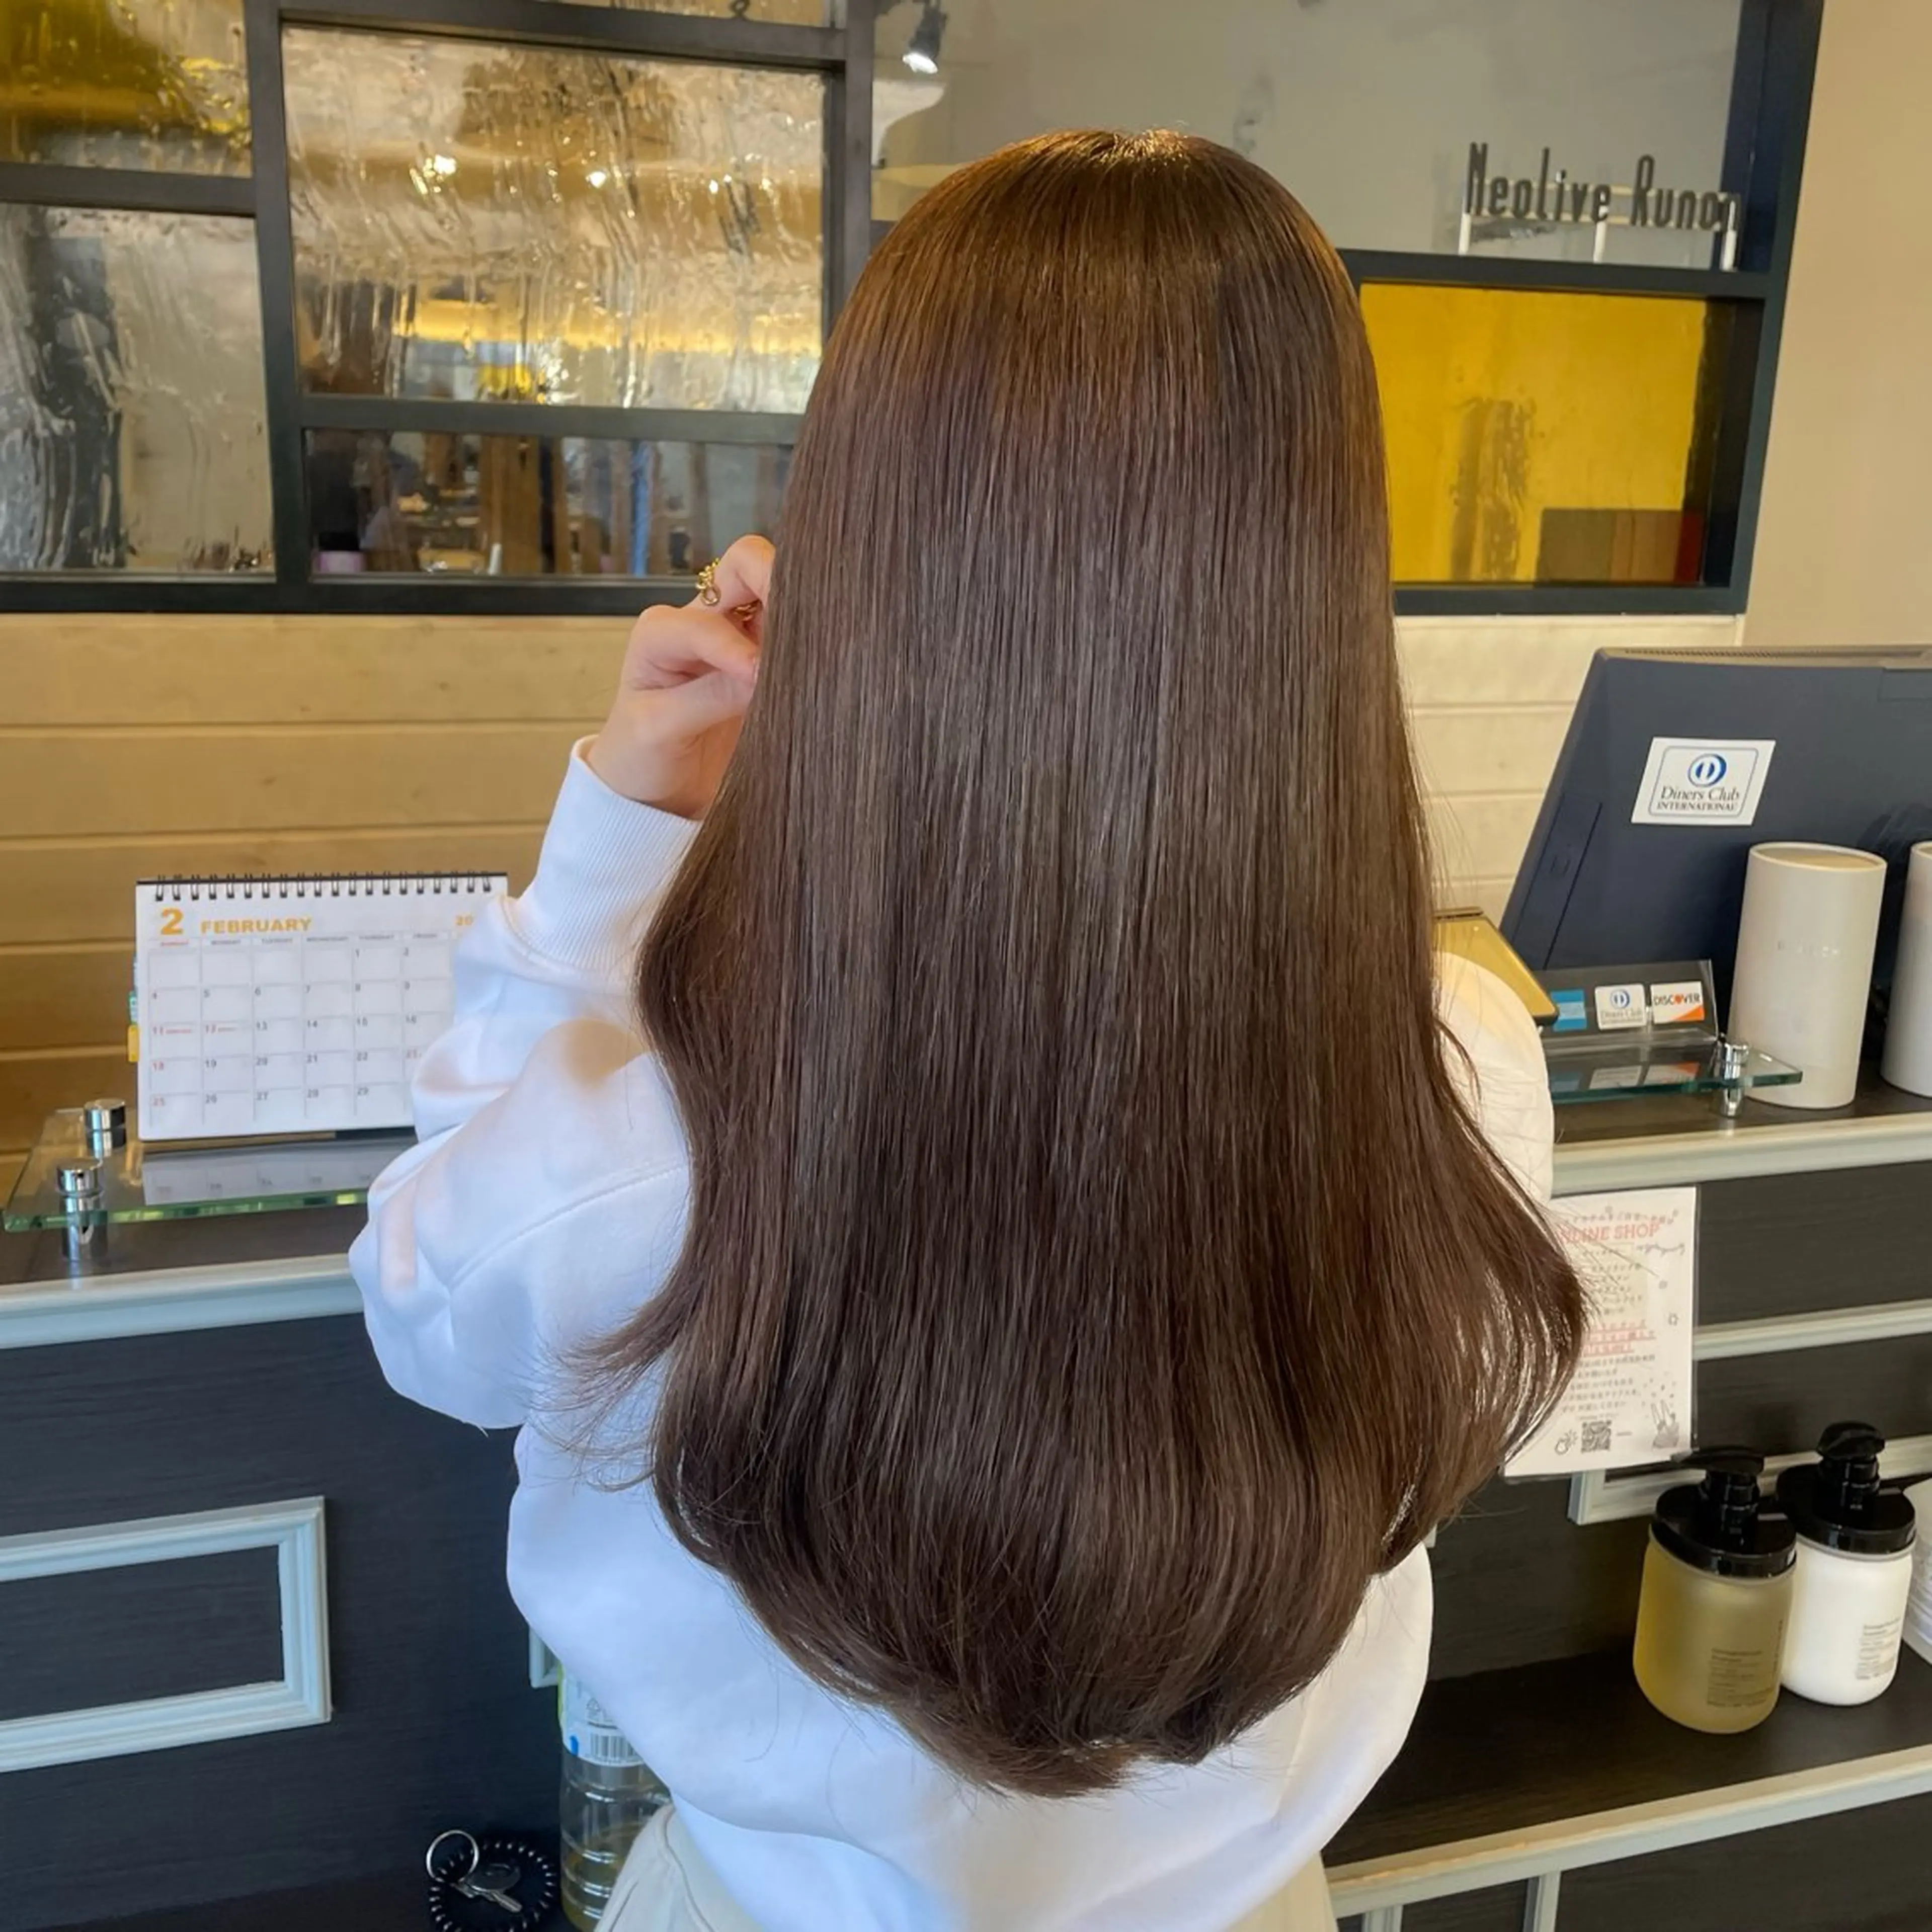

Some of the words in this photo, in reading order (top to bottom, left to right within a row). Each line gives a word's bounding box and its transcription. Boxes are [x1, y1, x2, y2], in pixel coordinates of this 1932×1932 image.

[1661, 785, 1705, 800] Diners
[1708, 786, 1739, 801] Club
[1656, 801, 1738, 811] INTERNATIONAL
[161, 908, 183, 935] 2
[201, 917, 312, 935] FEBRUARY
[455, 914, 474, 926] 20
[1654, 993, 1700, 1006] DISCOVER
[256, 1021, 268, 1030] 13
[307, 1019, 318, 1028] 14
[205, 1059, 217, 1068] 19
[307, 1054, 318, 1064] 21
[1614, 1221, 1660, 1239] SHOP
